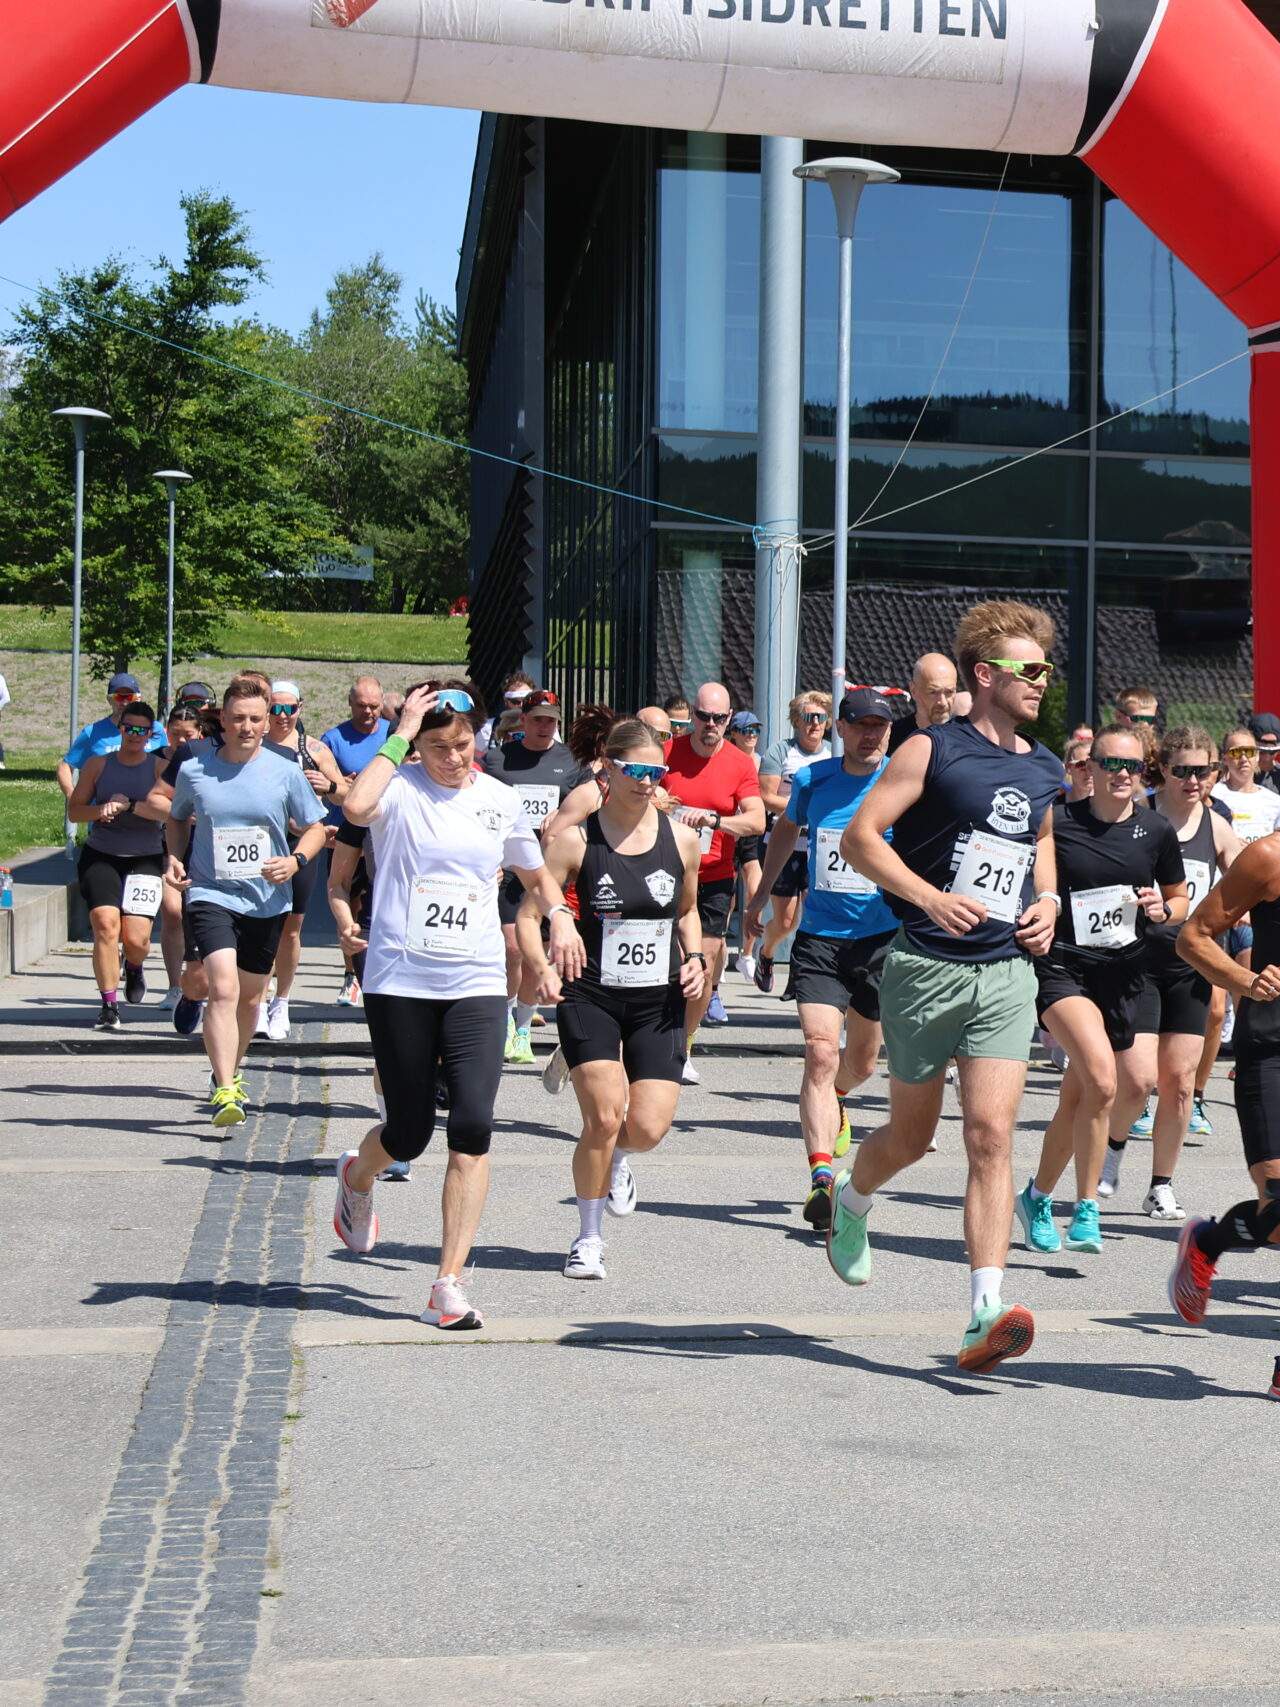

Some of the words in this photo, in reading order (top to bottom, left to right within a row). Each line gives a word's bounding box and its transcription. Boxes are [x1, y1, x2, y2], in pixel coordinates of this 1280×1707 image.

[523, 800, 549, 815] 233
[227, 844, 259, 863] 208
[973, 862, 1014, 896] 213
[132, 887, 156, 903] 253
[425, 903, 467, 931] 244
[1089, 908, 1123, 934] 246
[617, 943, 656, 966] 265
